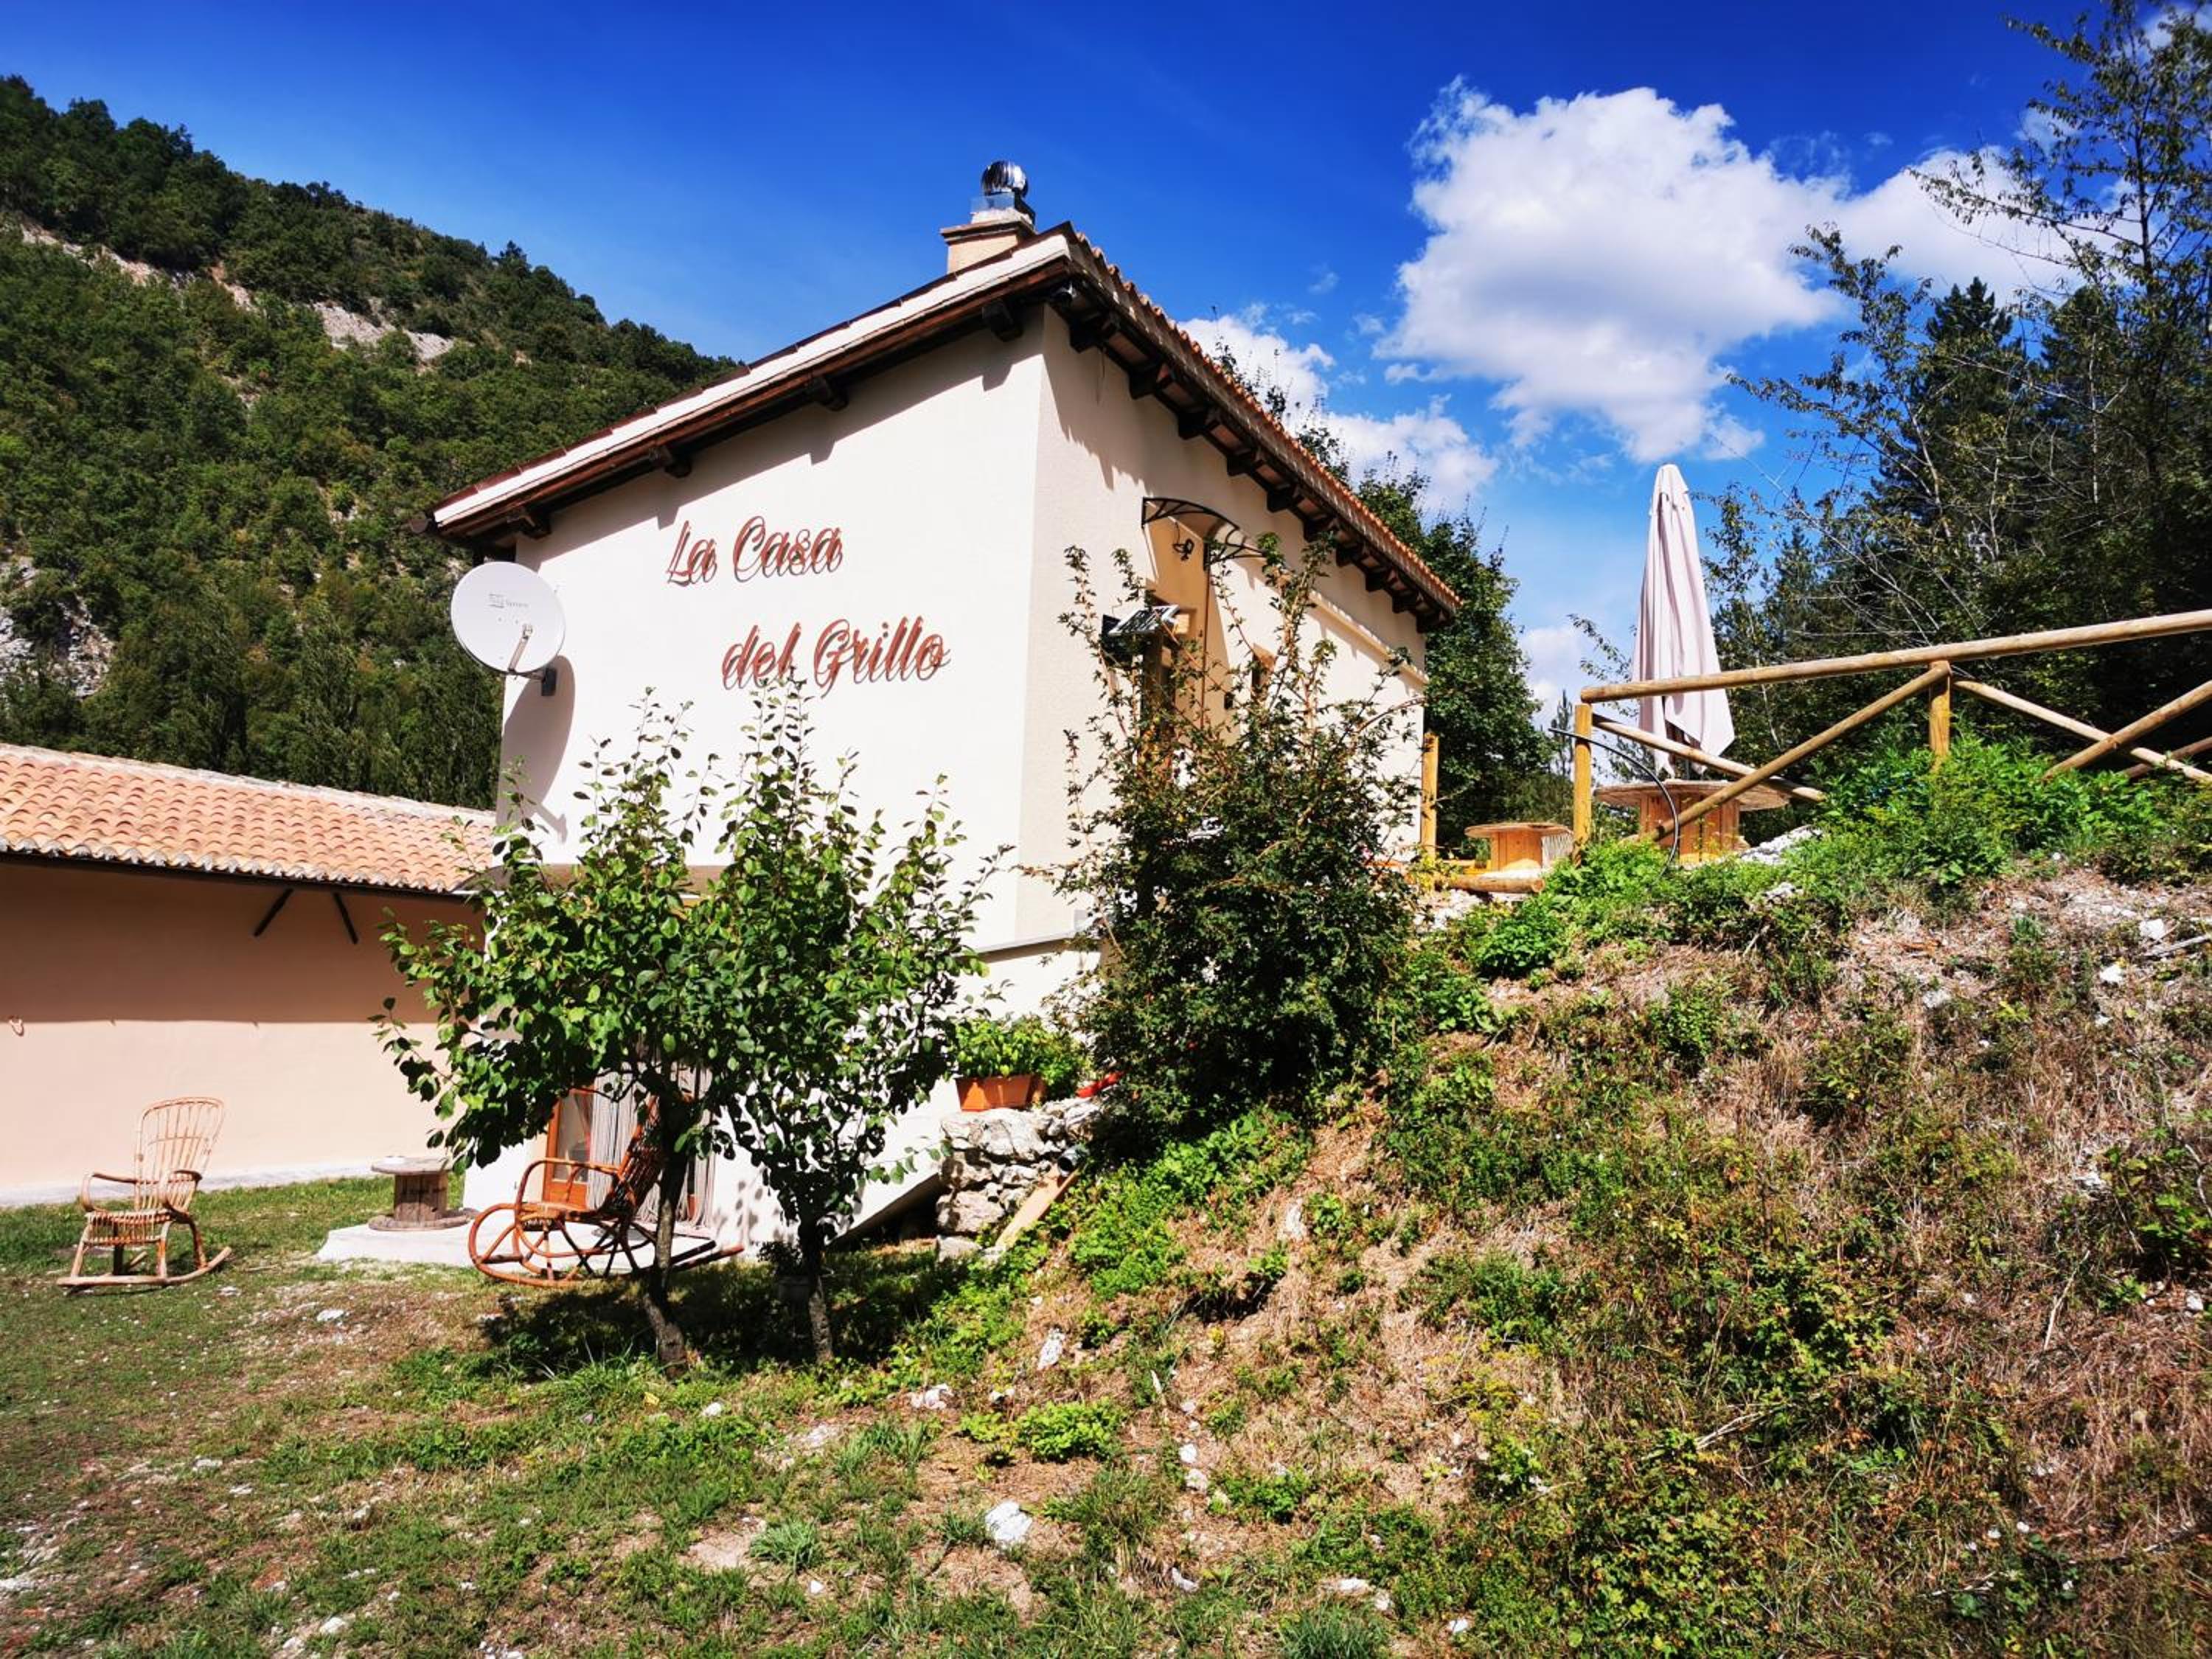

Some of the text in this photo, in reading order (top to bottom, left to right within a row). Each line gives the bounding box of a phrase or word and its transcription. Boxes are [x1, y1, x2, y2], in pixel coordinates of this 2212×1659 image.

[667, 515, 844, 582] La Casa
[721, 616, 948, 692] del Grillo
